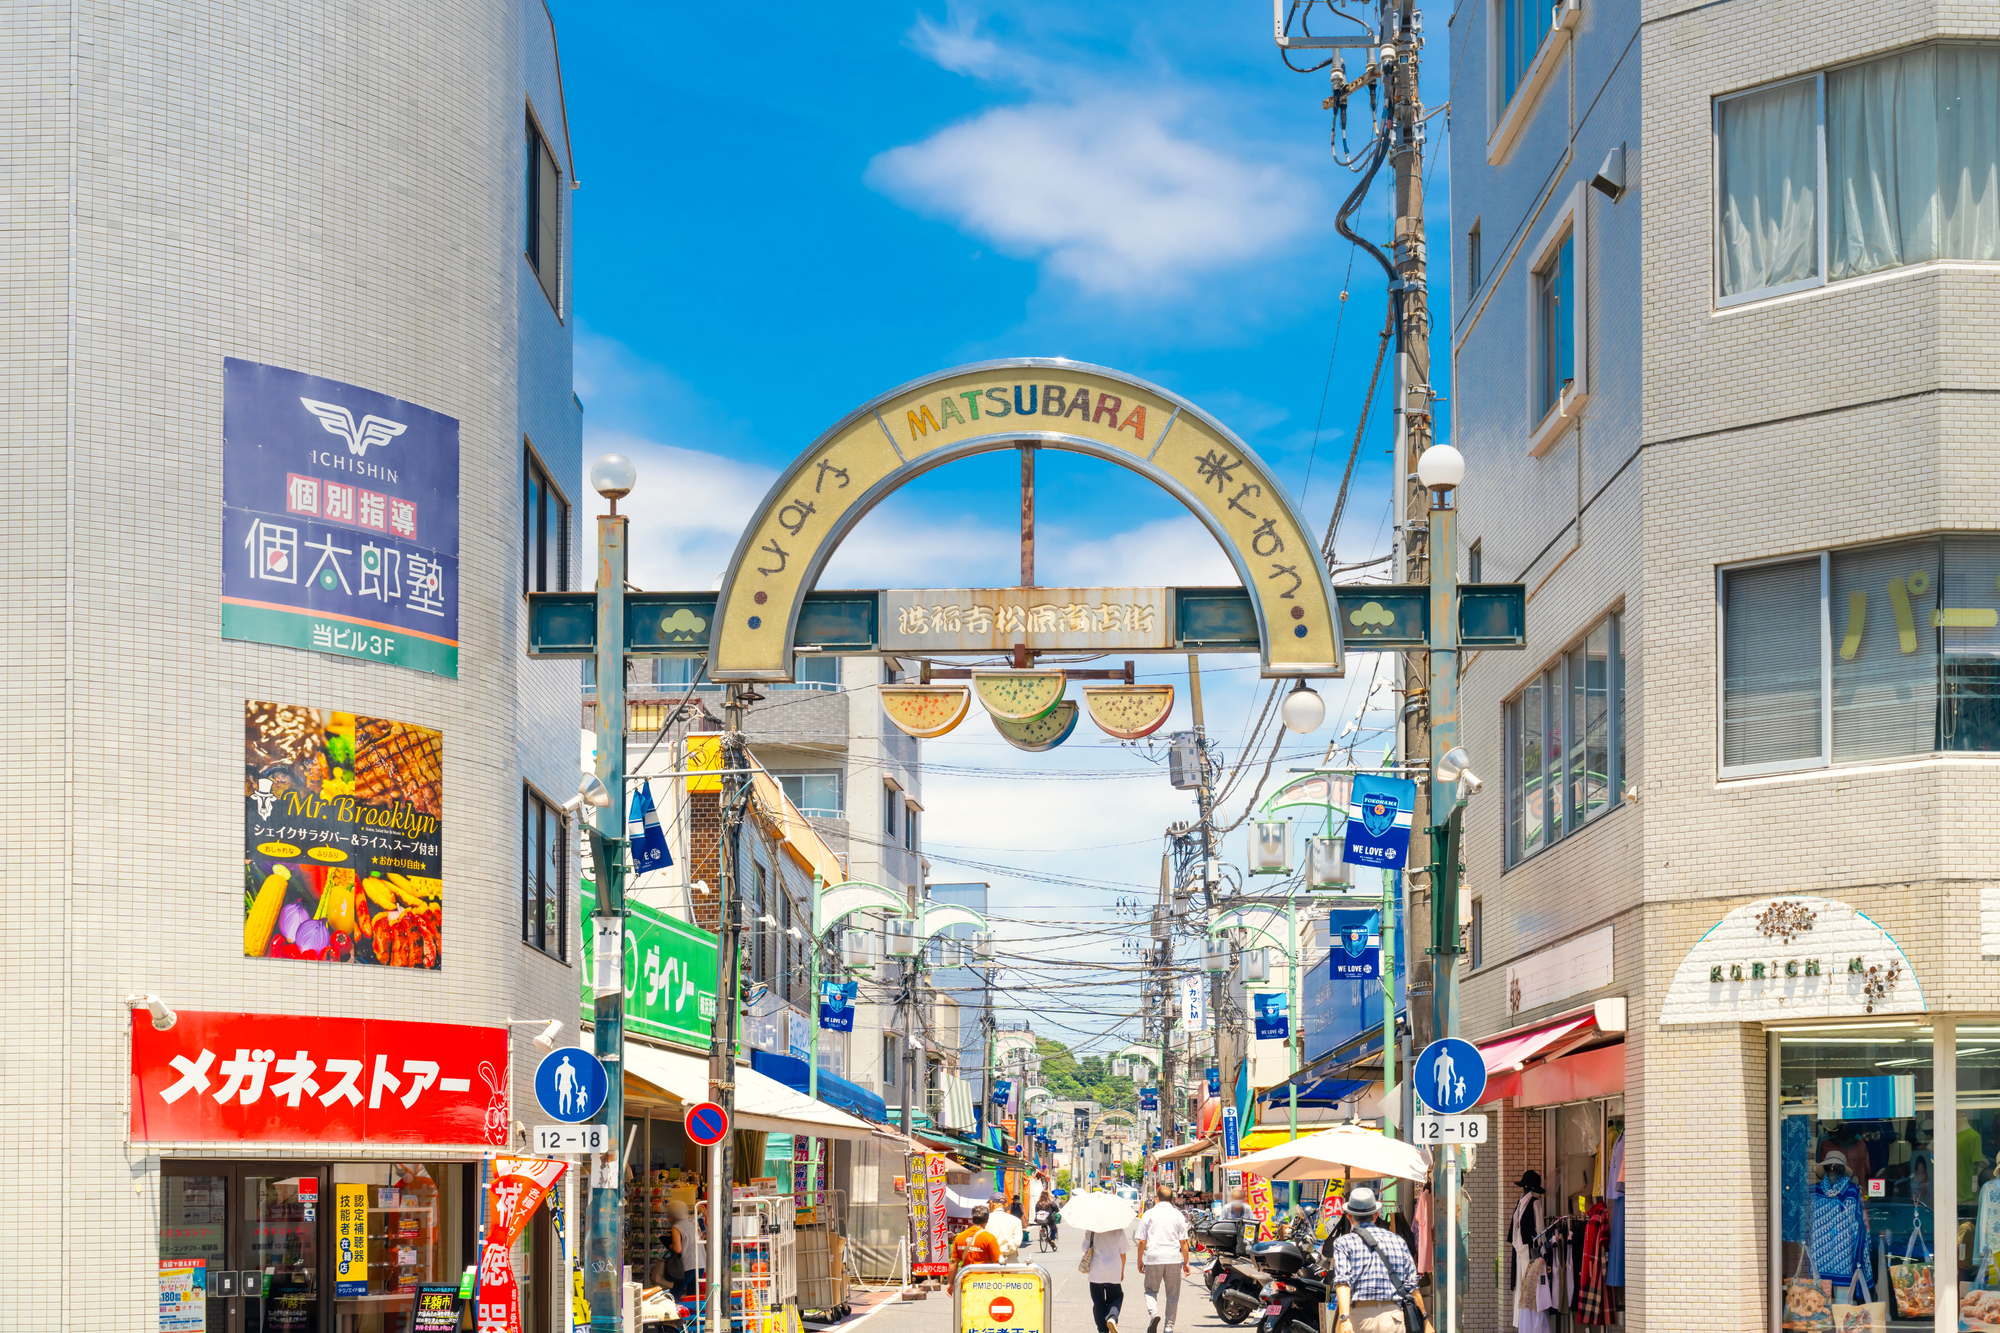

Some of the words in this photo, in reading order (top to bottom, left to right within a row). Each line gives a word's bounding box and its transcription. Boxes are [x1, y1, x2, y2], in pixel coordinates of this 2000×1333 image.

[906, 384, 1147, 441] MATSUBARA
[312, 449, 398, 484] ICHISHIN
[288, 475, 416, 537] 個別指導
[244, 517, 445, 617] 個太郎塾
[898, 602, 1155, 635] 洪福寺松原商店街
[1840, 570, 2000, 660] パー
[313, 623, 395, 657] 当ビル3F
[283, 791, 328, 820] Mr.
[334, 796, 439, 839] Brooklyn
[1364, 797, 1398, 807] YOKOHAMA
[265, 845, 295, 854] おしゃれな
[379, 856, 420, 871] おかわり自由
[1352, 843, 1364, 854] WE
[1365, 845, 1384, 857] LOVE
[644, 944, 695, 1013] ダイソー
[1189, 988, 1199, 1019] カットM
[159, 1048, 471, 1110] メガネストアー
[353, 1194, 364, 1262] 認定補聴器
[910, 1156, 929, 1262] 高価買取致します
[928, 1156, 947, 1261] 金・プラチナ
[161, 1291, 175, 1302] 180
[421, 1294, 450, 1310] 半額市
